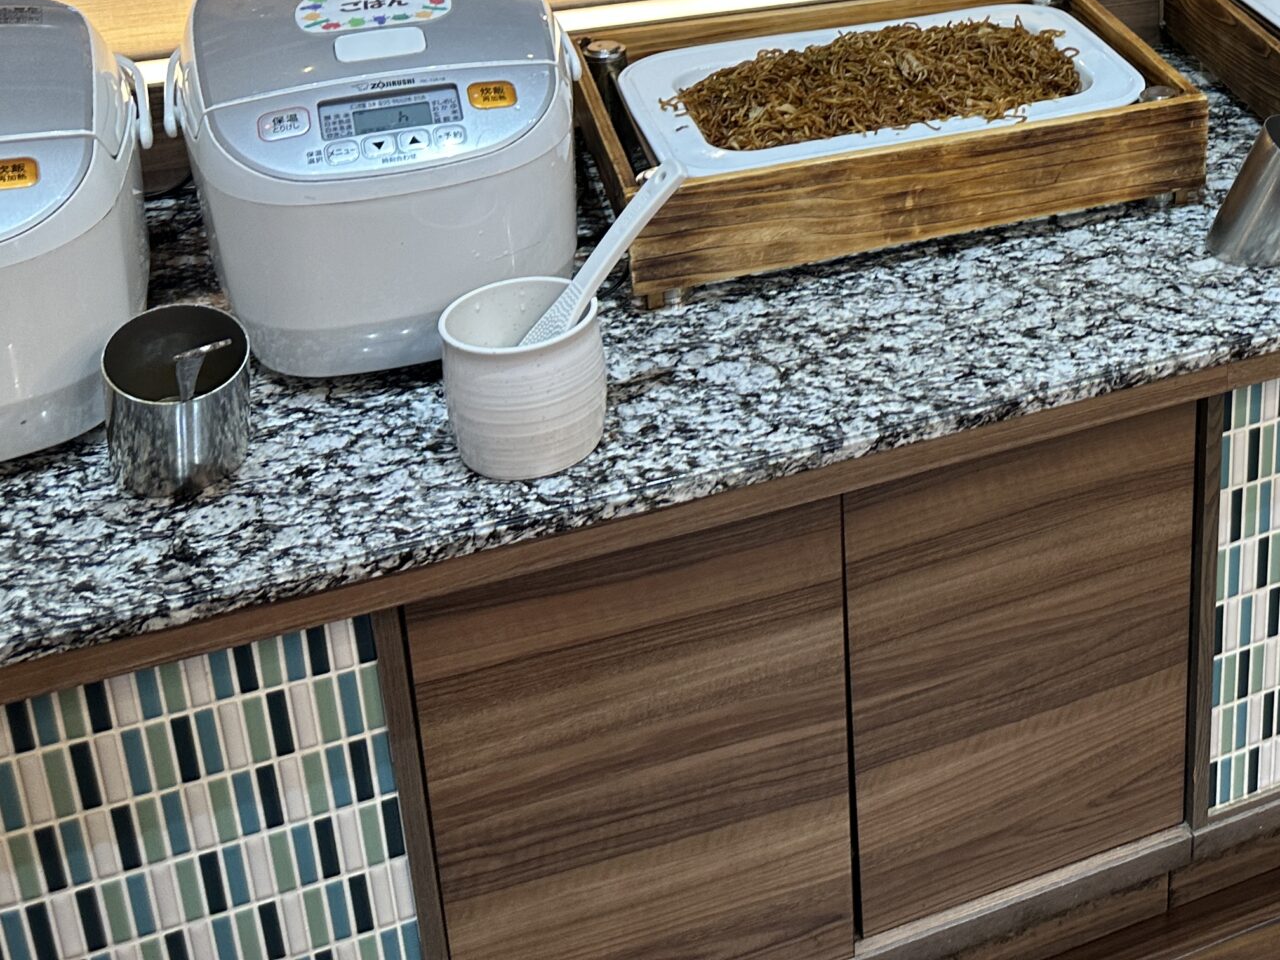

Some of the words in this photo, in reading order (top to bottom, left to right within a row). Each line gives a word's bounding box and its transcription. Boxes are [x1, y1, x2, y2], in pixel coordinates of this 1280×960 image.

[370, 78, 415, 90] ZOJIRUSHI
[272, 113, 298, 126] 保温
[329, 147, 356, 159] メニュー
